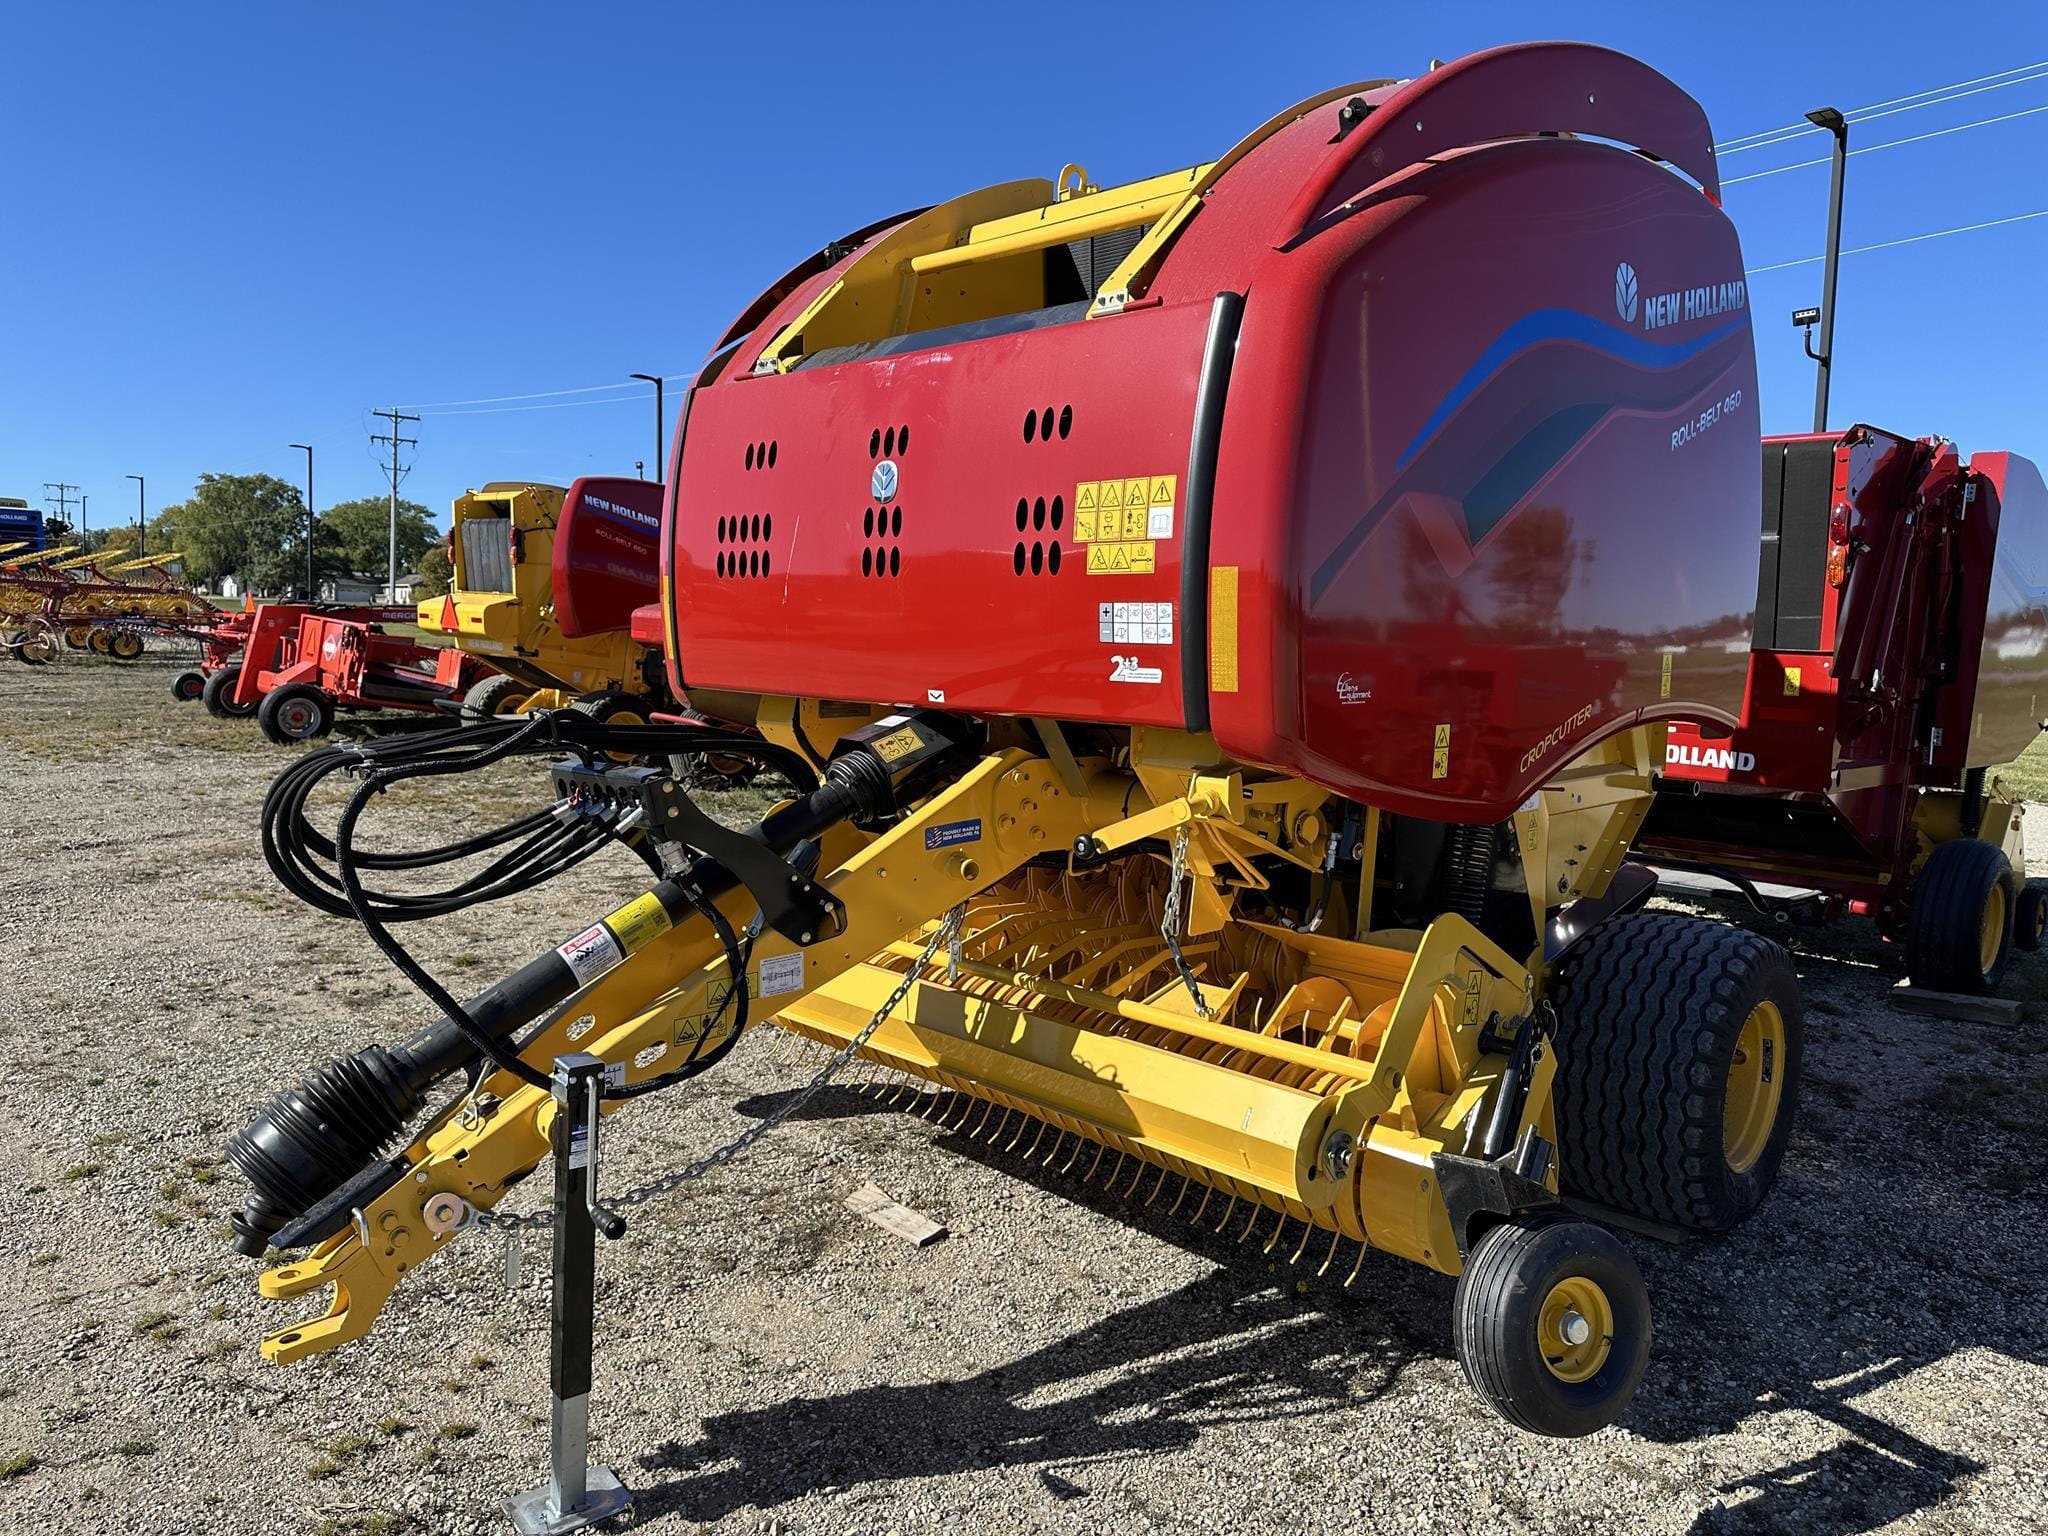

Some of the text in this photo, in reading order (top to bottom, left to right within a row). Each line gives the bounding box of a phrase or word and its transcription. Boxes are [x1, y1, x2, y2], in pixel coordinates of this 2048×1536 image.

[1645, 280, 1745, 330] NEW HOLLAND
[1671, 389, 1742, 452] ROLL-BELT 460
[584, 494, 659, 528] NEW HOLLAND
[1520, 704, 1592, 773] CROPCUTTER
[1665, 744, 1755, 772] OLLAND
[574, 929, 600, 947] DANGER
